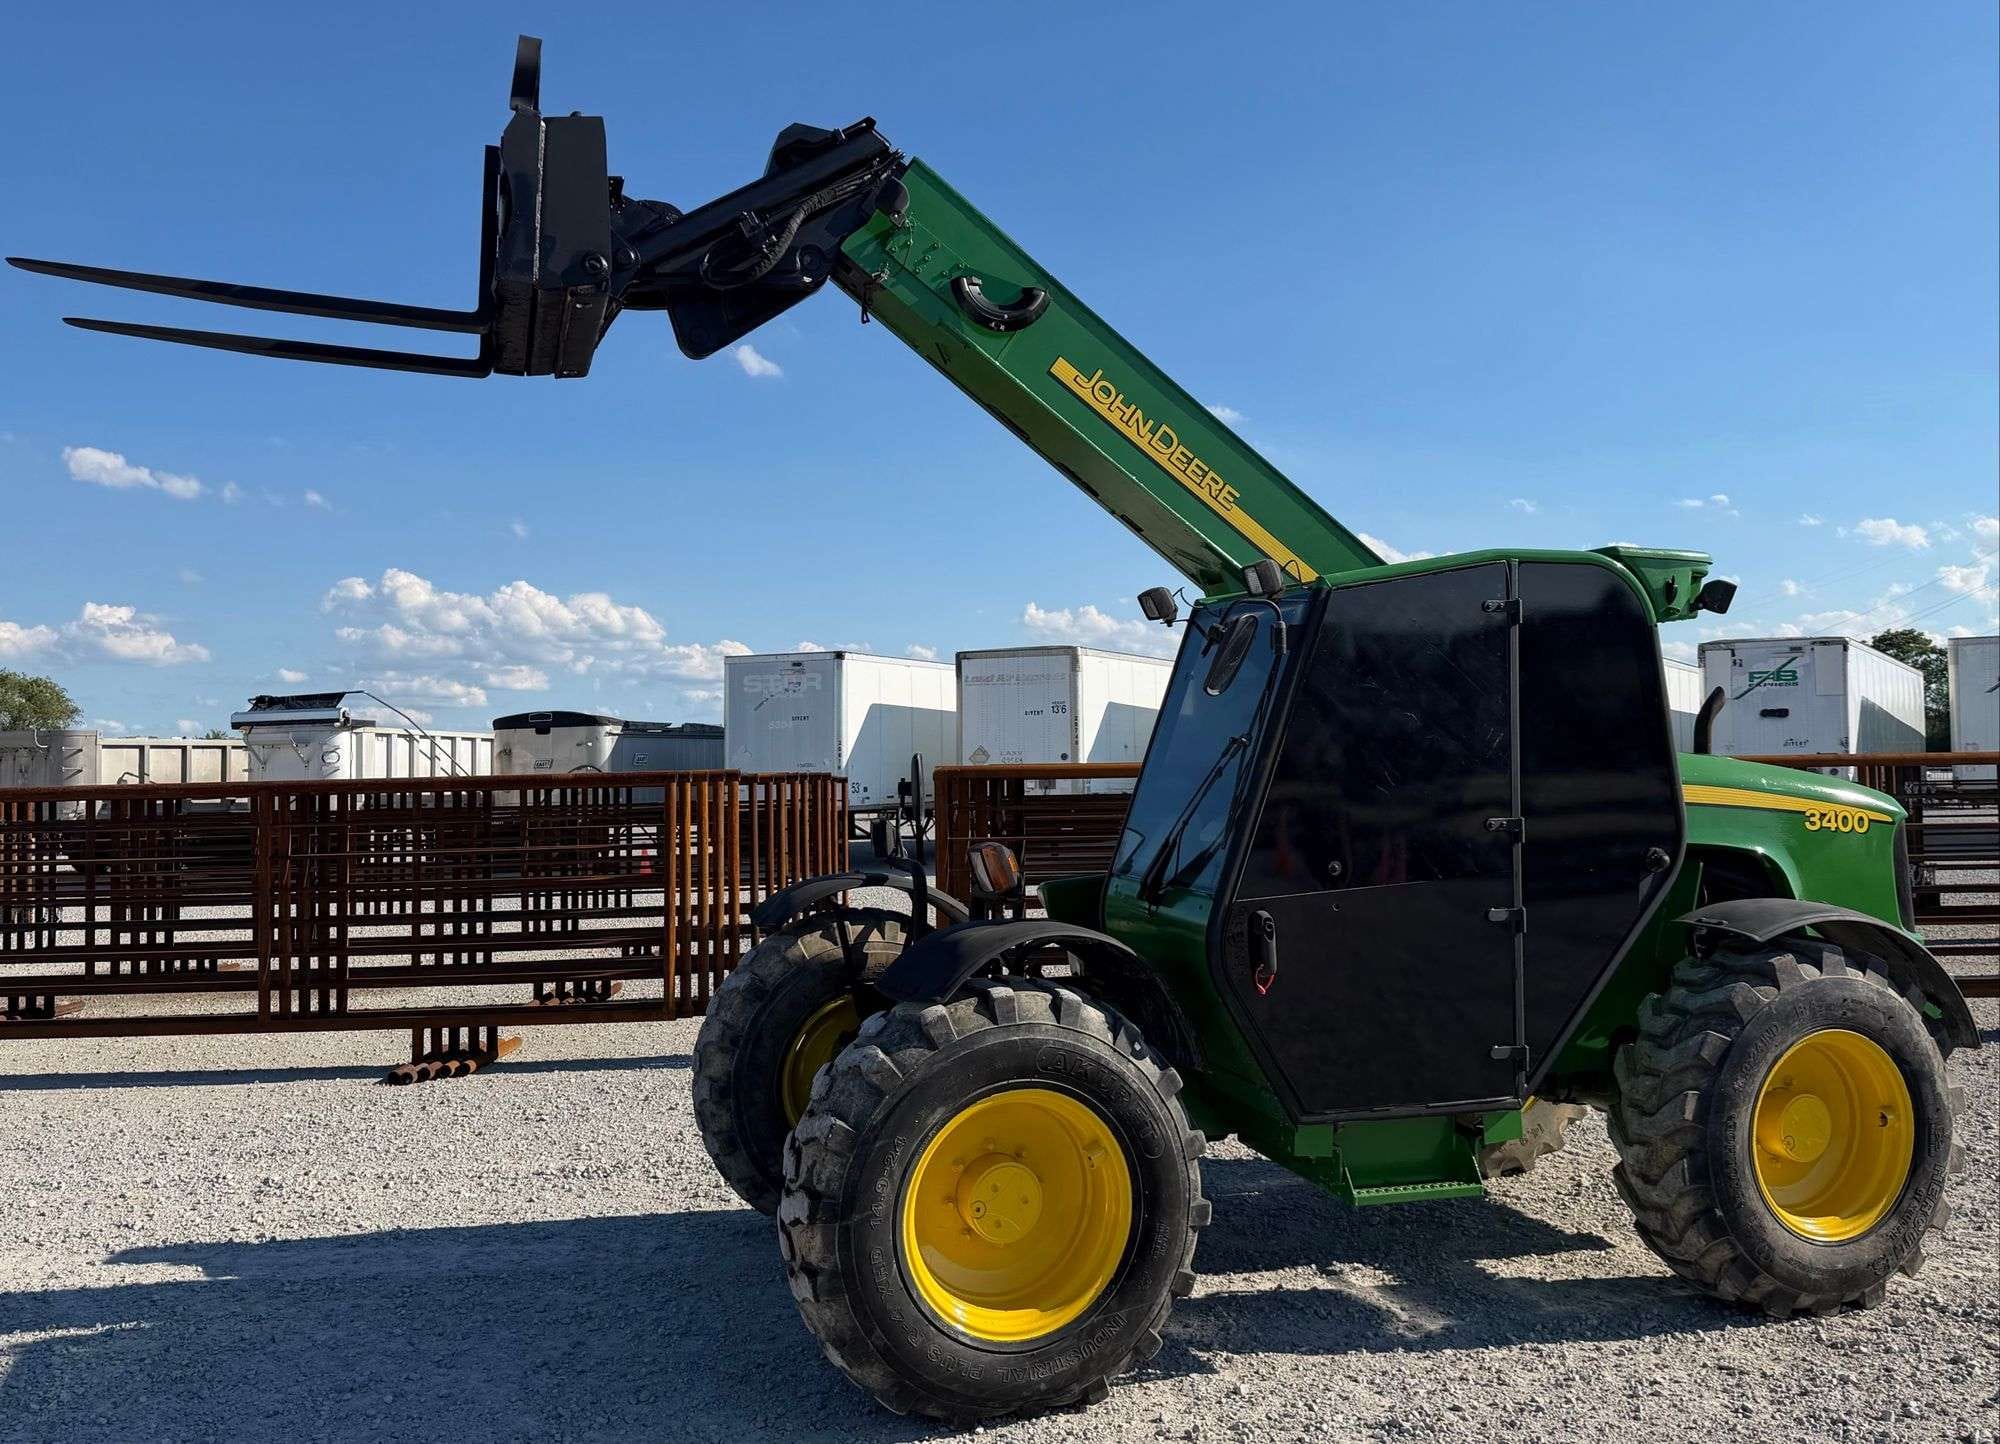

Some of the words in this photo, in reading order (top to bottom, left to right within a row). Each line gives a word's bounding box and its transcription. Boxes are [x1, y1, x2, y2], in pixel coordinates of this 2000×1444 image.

[1074, 368, 1154, 439] JOHN
[1149, 422, 1241, 512] DEERE
[1804, 808, 1869, 834] 3400
[926, 1343, 986, 1385] PLUS
